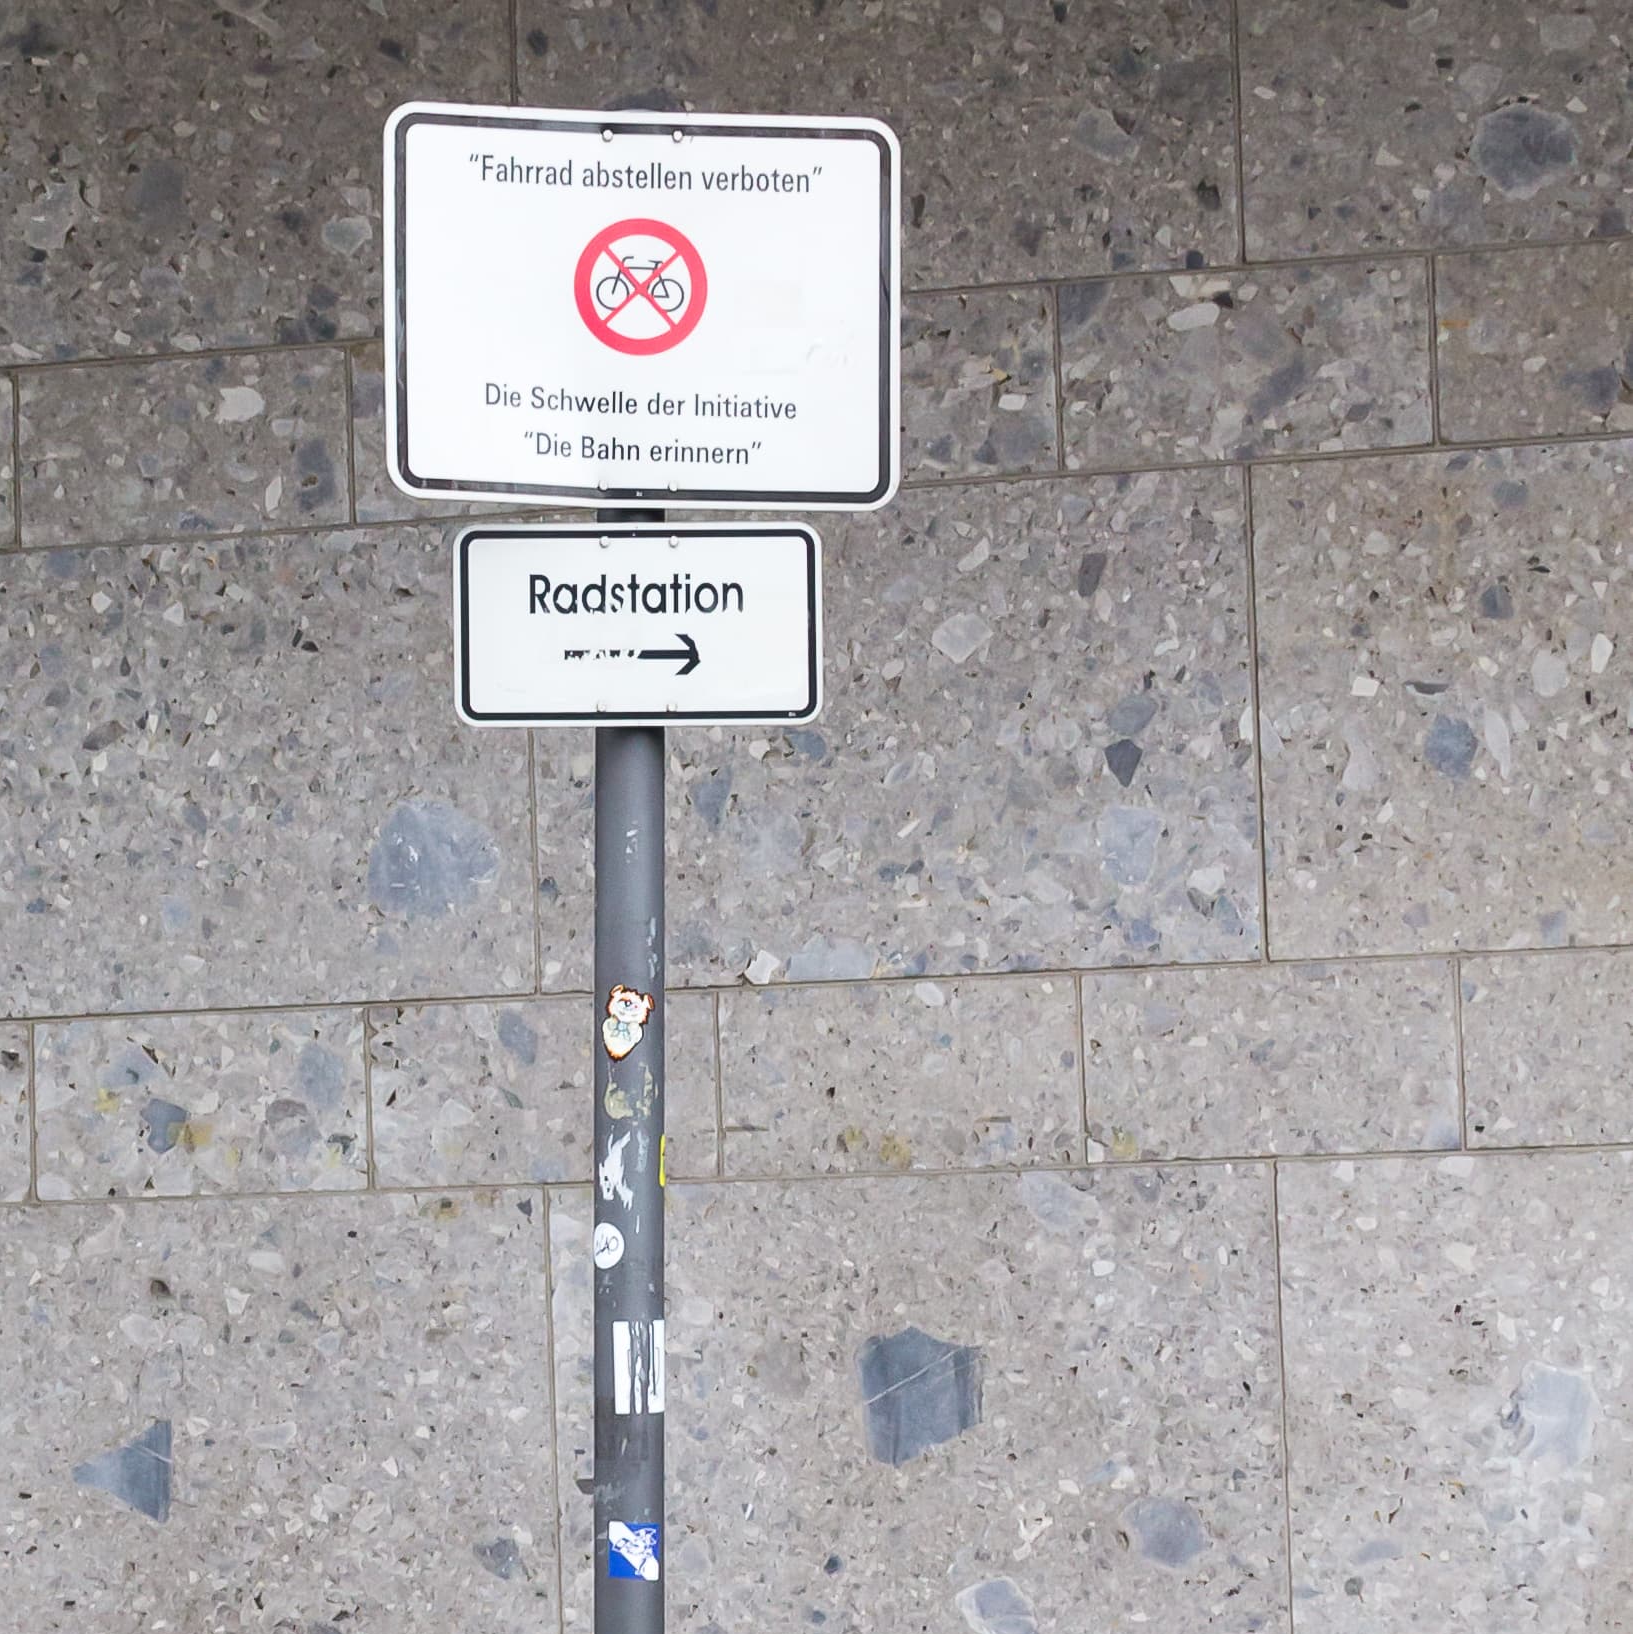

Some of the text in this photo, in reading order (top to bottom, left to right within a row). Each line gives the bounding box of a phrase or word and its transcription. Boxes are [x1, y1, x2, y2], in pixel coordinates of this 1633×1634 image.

[469, 153, 823, 193] "Fahrrad abstellen verboten"
[485, 382, 797, 420] Die Schwelle der Initiative
[524, 431, 762, 465] "Die Bahn erinnern"
[528, 573, 744, 615] Radstation
